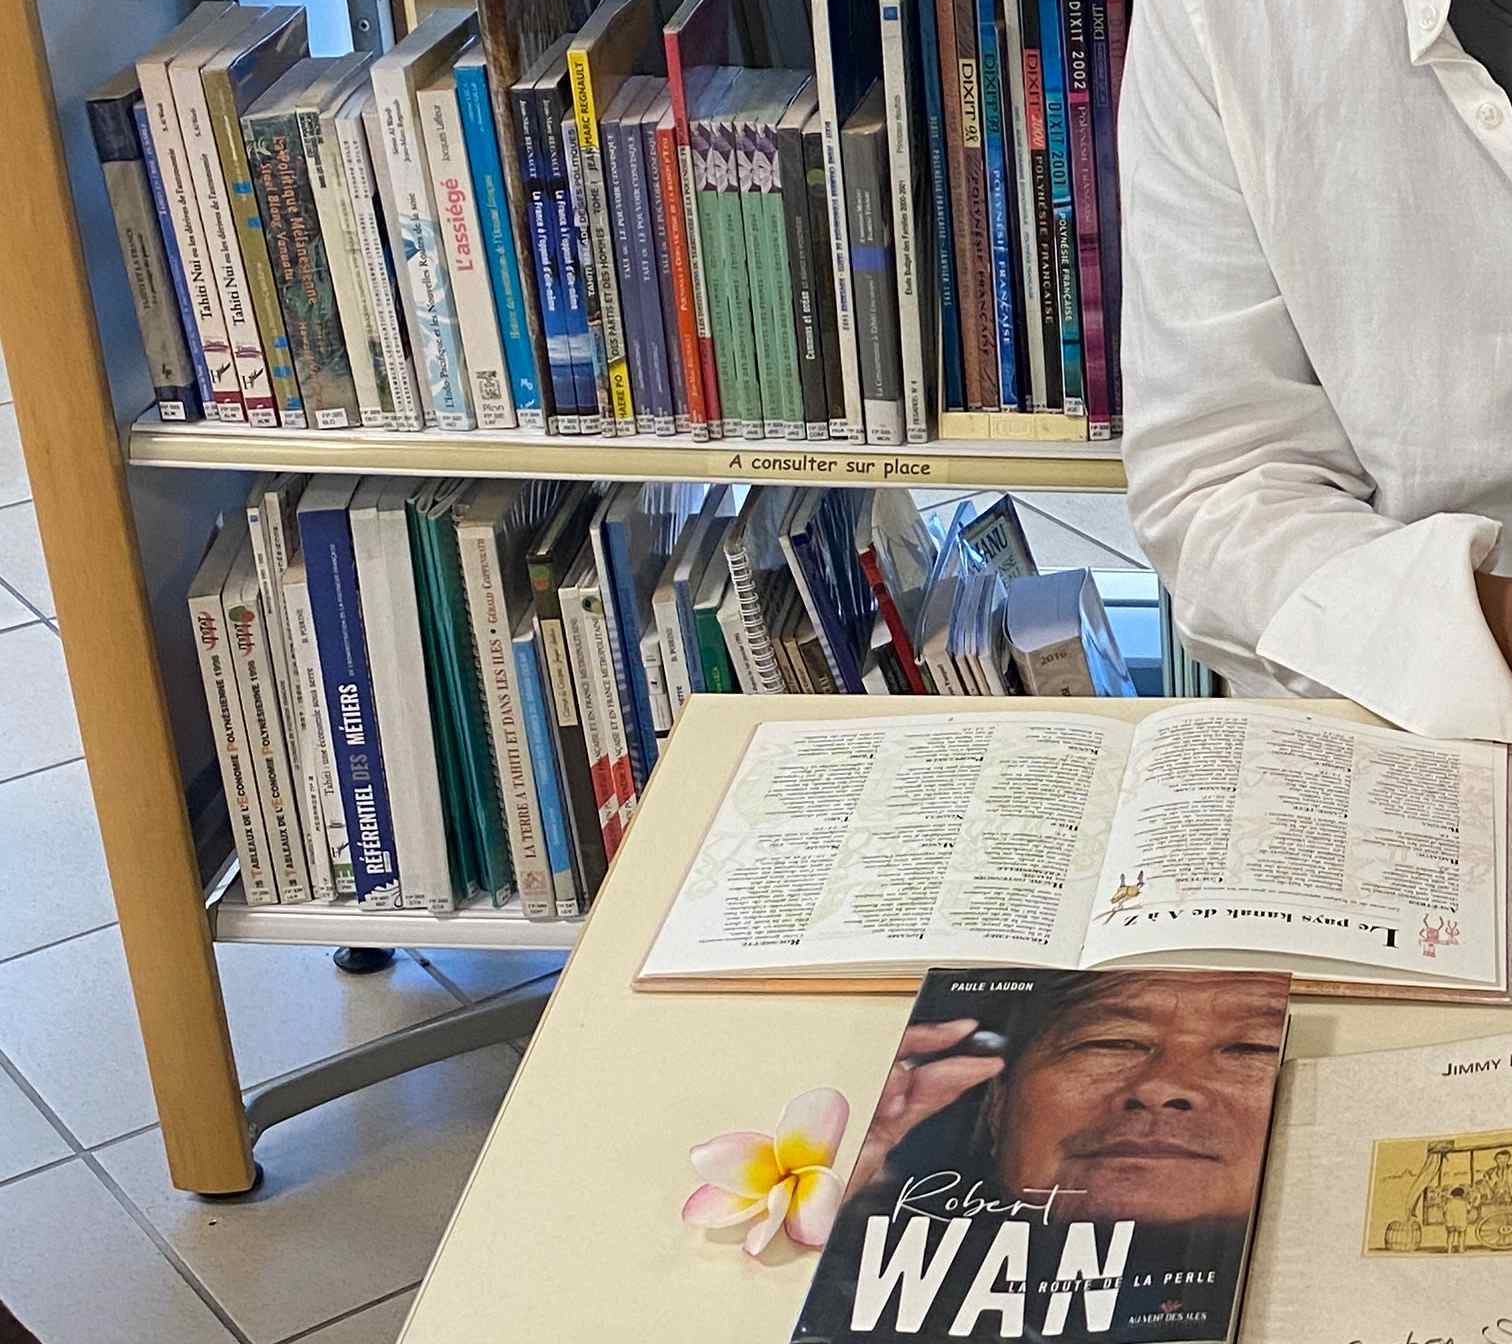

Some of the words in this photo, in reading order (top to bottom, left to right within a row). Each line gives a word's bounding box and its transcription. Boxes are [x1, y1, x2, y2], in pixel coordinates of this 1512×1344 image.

[1068, 0, 1085, 43] DIXIT
[1071, 50, 1088, 90] 2002
[440, 177, 475, 272] L'assiégé
[729, 454, 743, 471] A
[750, 453, 839, 473] consulter
[845, 458, 876, 475] sur
[882, 457, 931, 478] place
[338, 683, 366, 745] MÉTIERS
[351, 753, 372, 781] DES
[354, 784, 386, 874] RÉFÉRENTIEL
[1168, 909, 1187, 921] A
[1191, 908, 1217, 919] de
[1227, 908, 1293, 925] kanak
[1302, 914, 1350, 930] pays
[1358, 922, 1401, 950] Le
[951, 981, 986, 992] PAULE
[990, 981, 1034, 992] LAUDON
[892, 1171, 1088, 1227] Robert
[849, 1215, 1137, 1339] WAN
[1008, 1280, 1026, 1294] LA
[1038, 1278, 1093, 1294] ROUTE
[1103, 1276, 1122, 1289] DE
[1133, 1273, 1152, 1288] LA
[1163, 1270, 1217, 1286] PERLE
